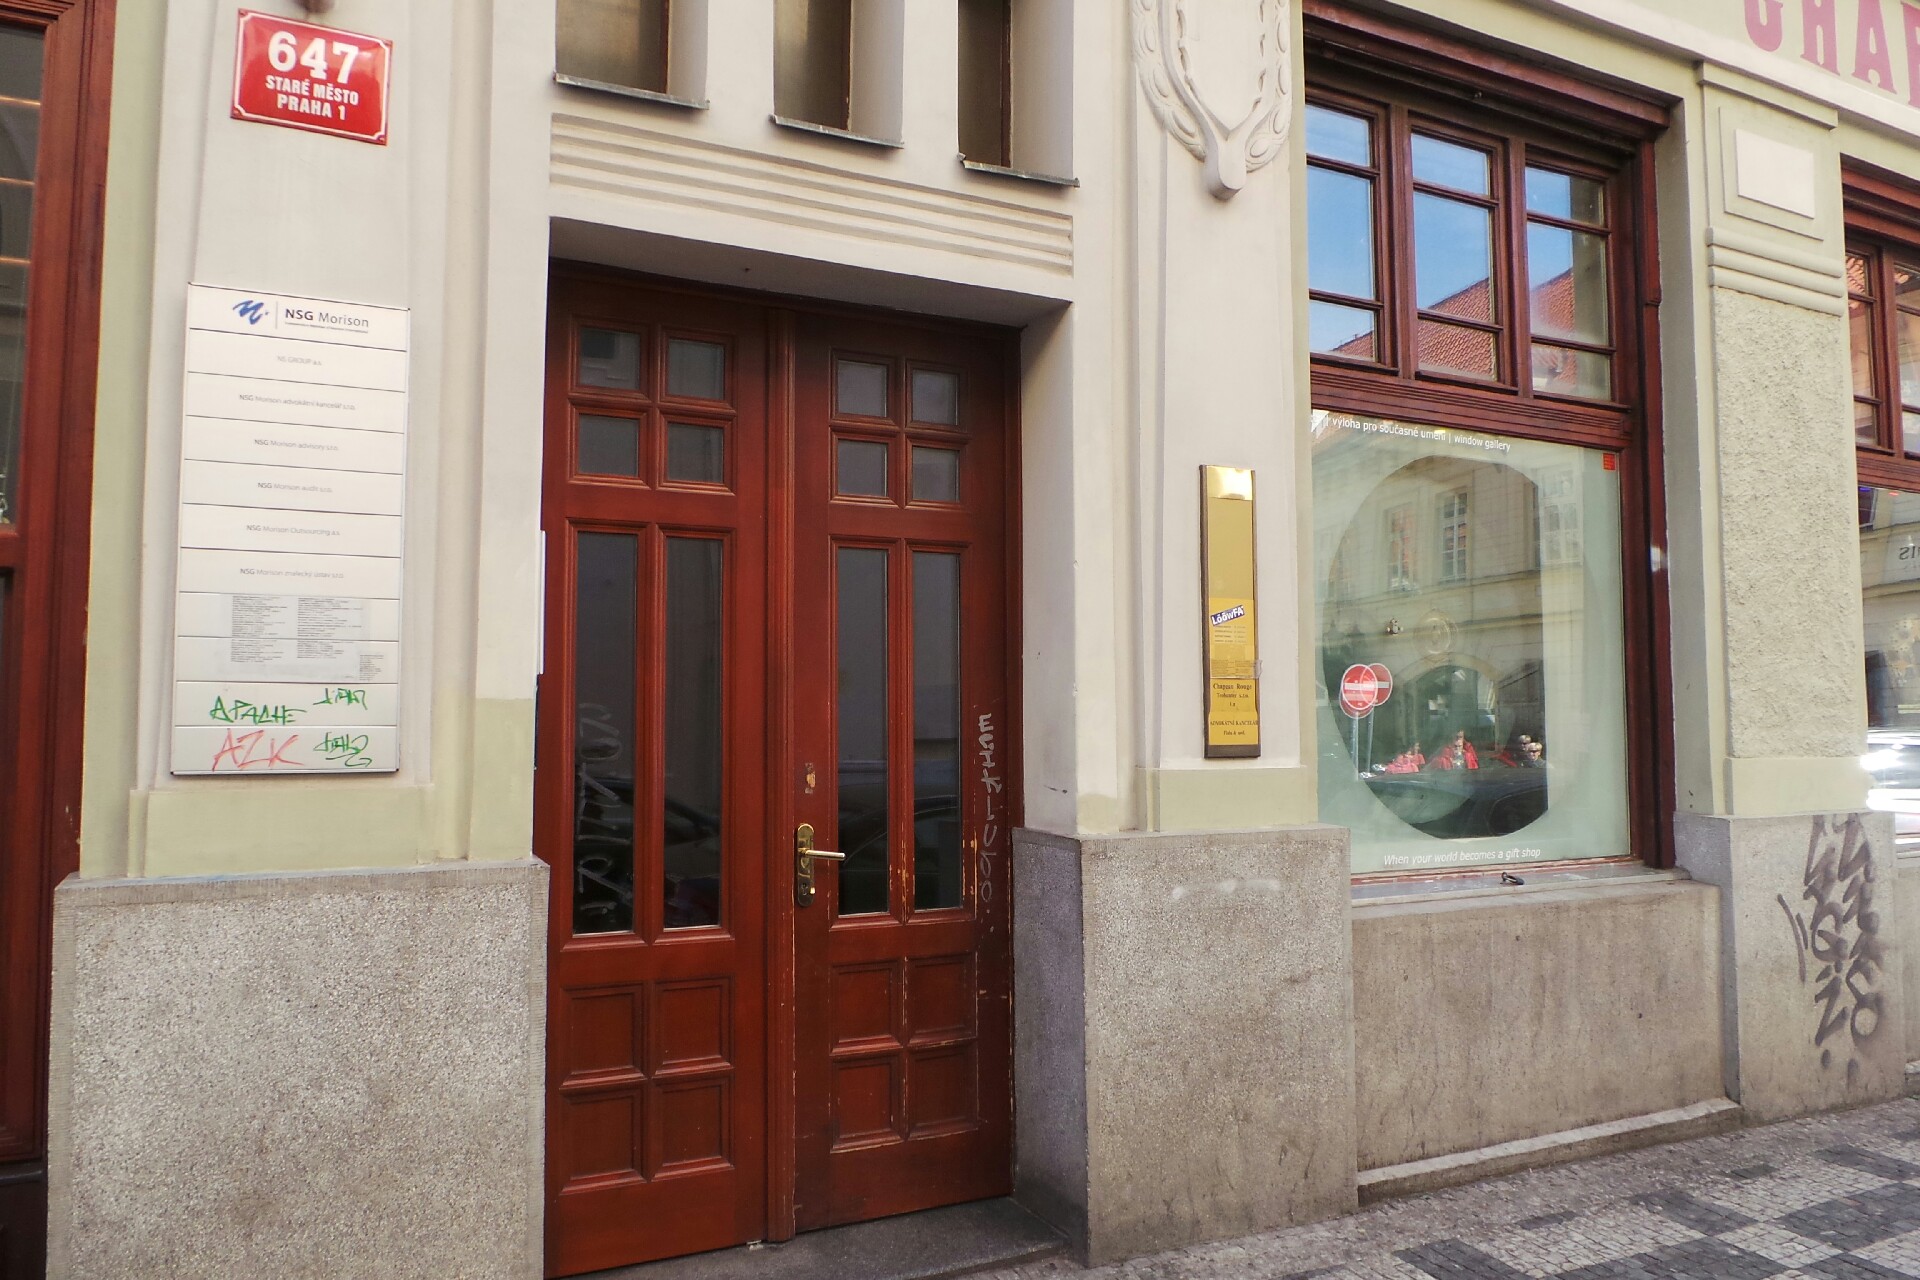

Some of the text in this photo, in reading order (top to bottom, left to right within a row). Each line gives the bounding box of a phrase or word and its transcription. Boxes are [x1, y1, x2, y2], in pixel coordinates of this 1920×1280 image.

[268, 30, 359, 84] 647
[265, 74, 359, 106] STARÉ MĚSTO
[277, 94, 346, 120] PRAHA 1
[285, 308, 369, 327] NSG Morison
[288, 357, 311, 365] GROUP
[239, 394, 254, 402] NSG
[255, 396, 282, 404] Morison
[283, 397, 314, 408] advokátní
[1332, 416, 1361, 429] výloha
[1363, 422, 1378, 431] pro
[1379, 425, 1419, 437] současné
[1454, 434, 1483, 447] window
[1484, 440, 1511, 453] gallery
[270, 440, 297, 449] Morison
[298, 442, 325, 451] advisory
[273, 483, 300, 491] Morison
[246, 524, 261, 532] NSG
[290, 527, 331, 537] Outsourcing
[256, 569, 284, 577] Morison
[1384, 847, 1541, 865] When your world becomes a gift shop
